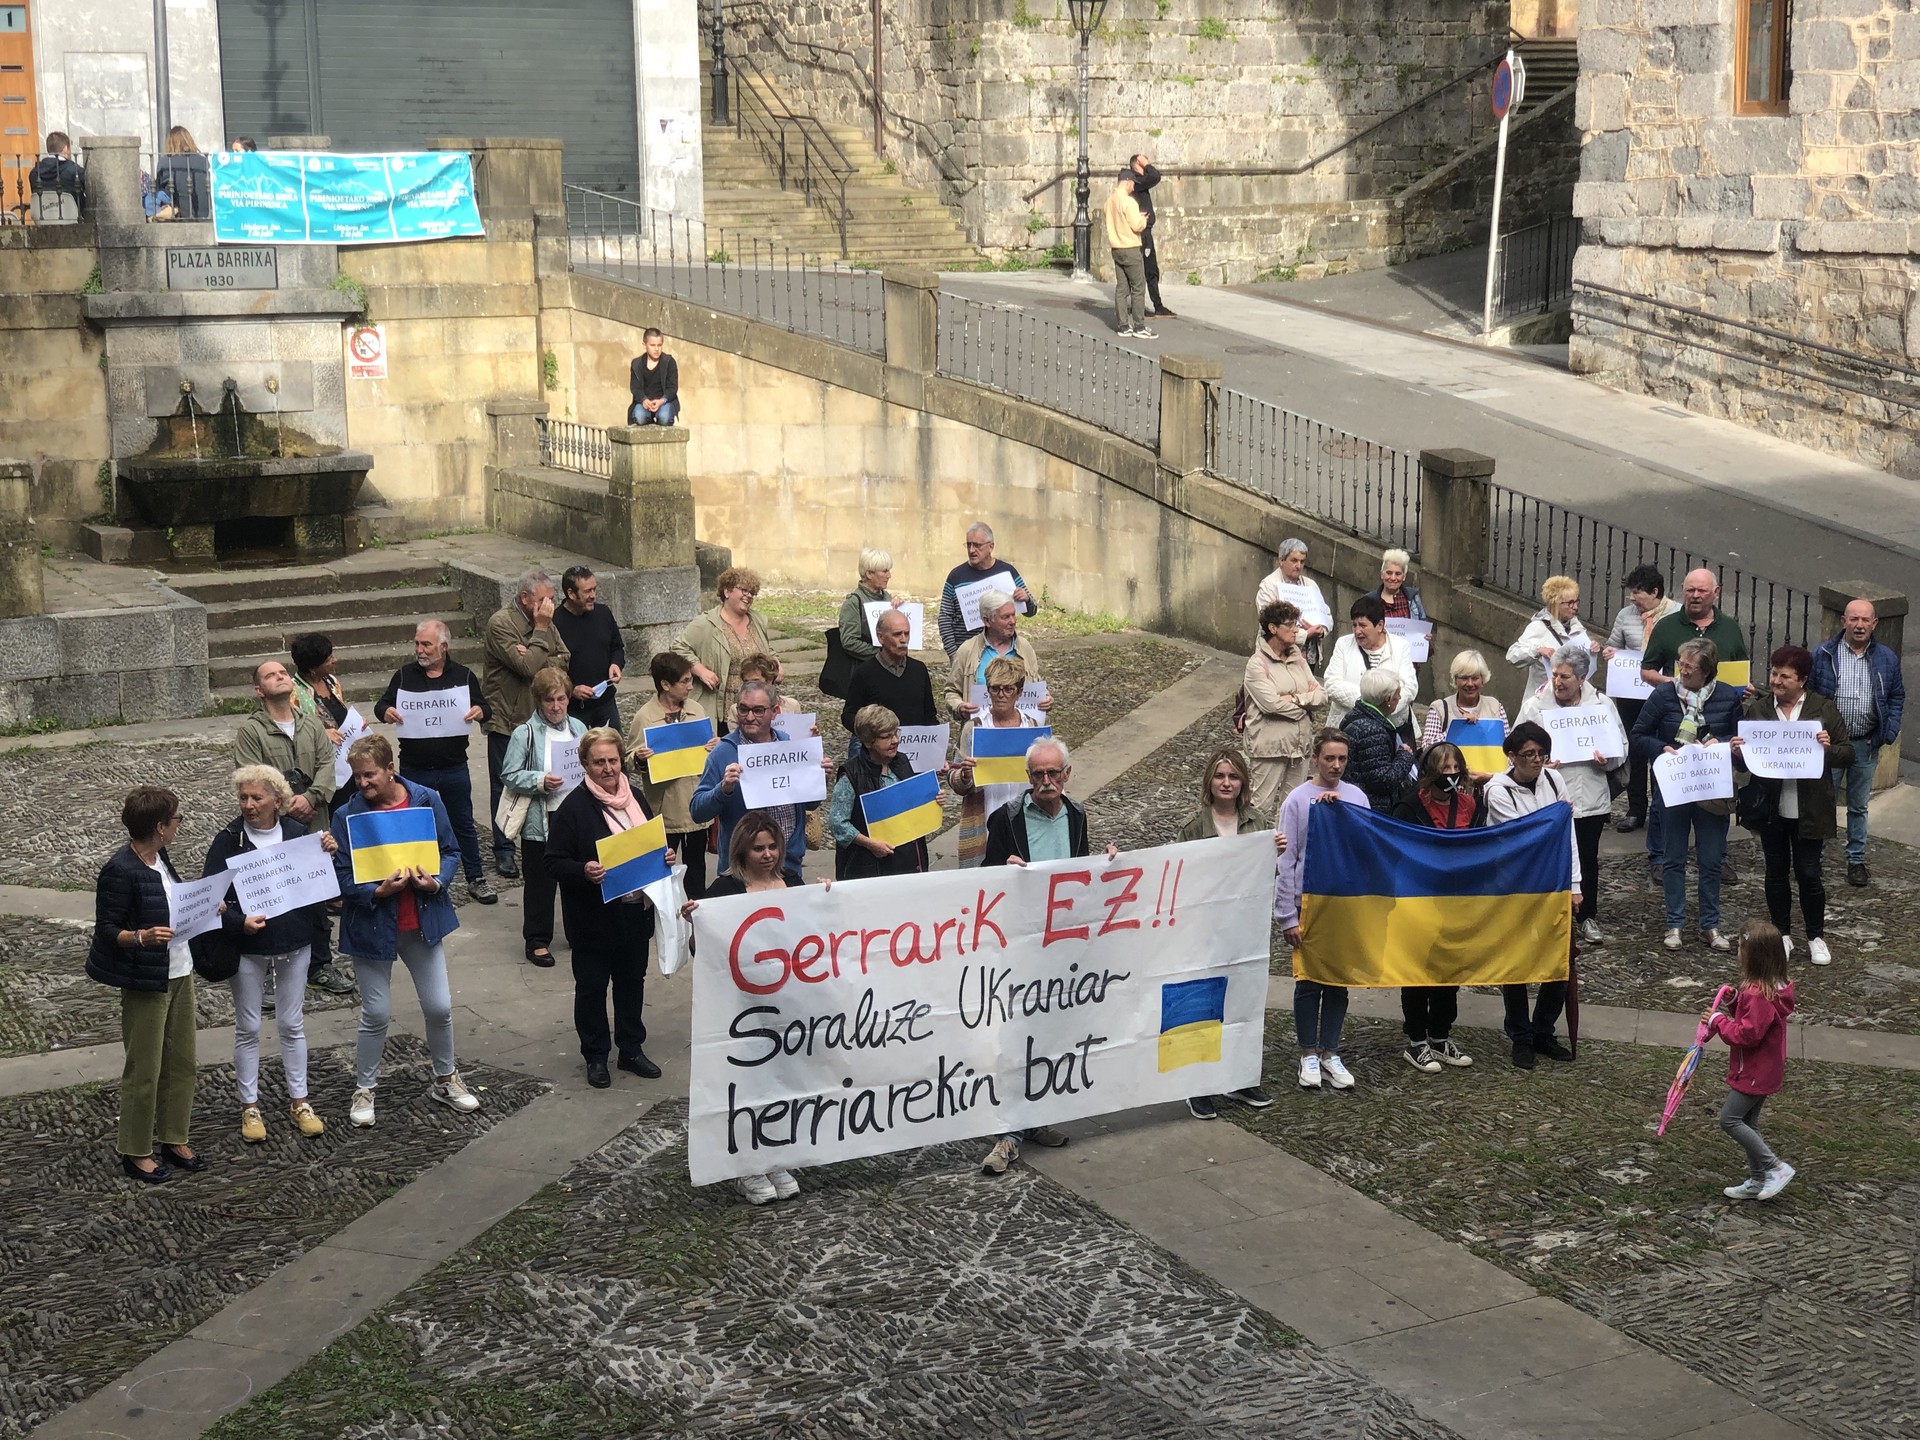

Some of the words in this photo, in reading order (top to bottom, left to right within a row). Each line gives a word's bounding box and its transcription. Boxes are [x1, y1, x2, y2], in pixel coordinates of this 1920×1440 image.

[7, 10, 13, 27] 1
[170, 252, 212, 269] PLAZA
[217, 251, 273, 268] BARRIXA
[204, 275, 234, 287] 1830
[400, 698, 458, 710] GERRARIK
[425, 716, 442, 727] EZ!
[1550, 713, 1609, 730] GERRARIK
[899, 734, 938, 744] RRARIK
[1576, 736, 1595, 747] EZ!
[1752, 730, 1778, 739] STOP
[1782, 730, 1816, 741] PUTIN,
[1751, 746, 1771, 755] UTZI
[1777, 746, 1812, 755] BAKEAN
[746, 750, 809, 769] GERRARIK
[1665, 754, 1688, 768] STOP
[1692, 752, 1723, 762] PUTIN,
[1761, 761, 1806, 769] UKRAINIA!
[772, 775, 791, 789] EZ!
[1670, 771, 1687, 782] UTZI
[1690, 767, 1720, 778] BAKEAN
[1681, 782, 1715, 794] UKRAINIA!
[237, 852, 287, 874] UKRAINIAKO
[241, 863, 296, 886] HERRIAREKIN,
[246, 886, 272, 900] BIHAR
[275, 875, 303, 890] GUREA
[307, 868, 328, 880] IZAN
[726, 987, 934, 1067] Soraluze
[1024, 1033, 1108, 1102] bat
